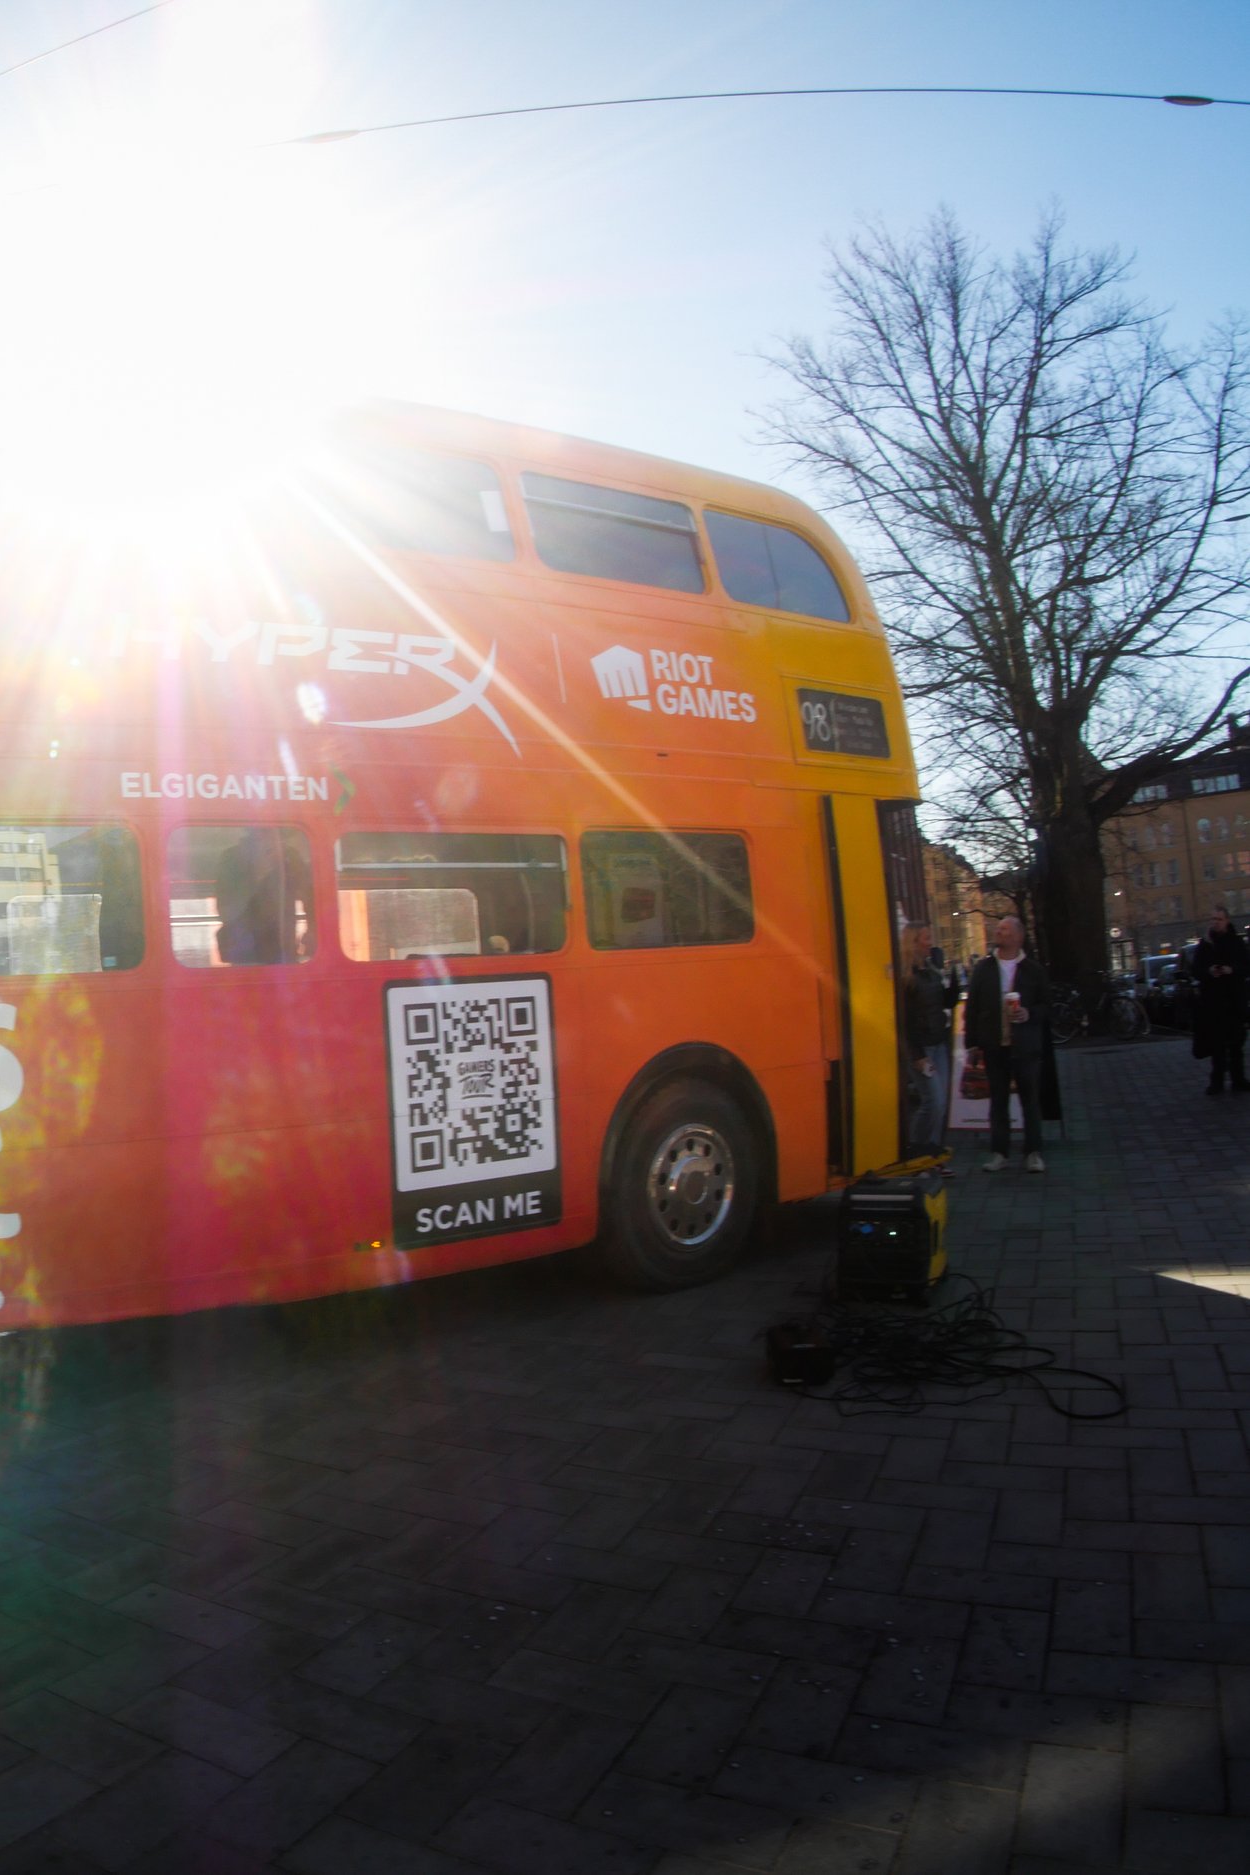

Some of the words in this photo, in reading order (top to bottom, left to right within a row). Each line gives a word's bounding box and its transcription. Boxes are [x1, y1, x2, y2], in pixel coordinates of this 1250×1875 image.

[650, 648, 713, 686] RIOT
[656, 683, 757, 723] GAMES
[801, 701, 831, 742] 98
[120, 771, 329, 801] ELGIGANTEN
[416, 1198, 495, 1233] SCAN
[503, 1190, 543, 1219] ME
